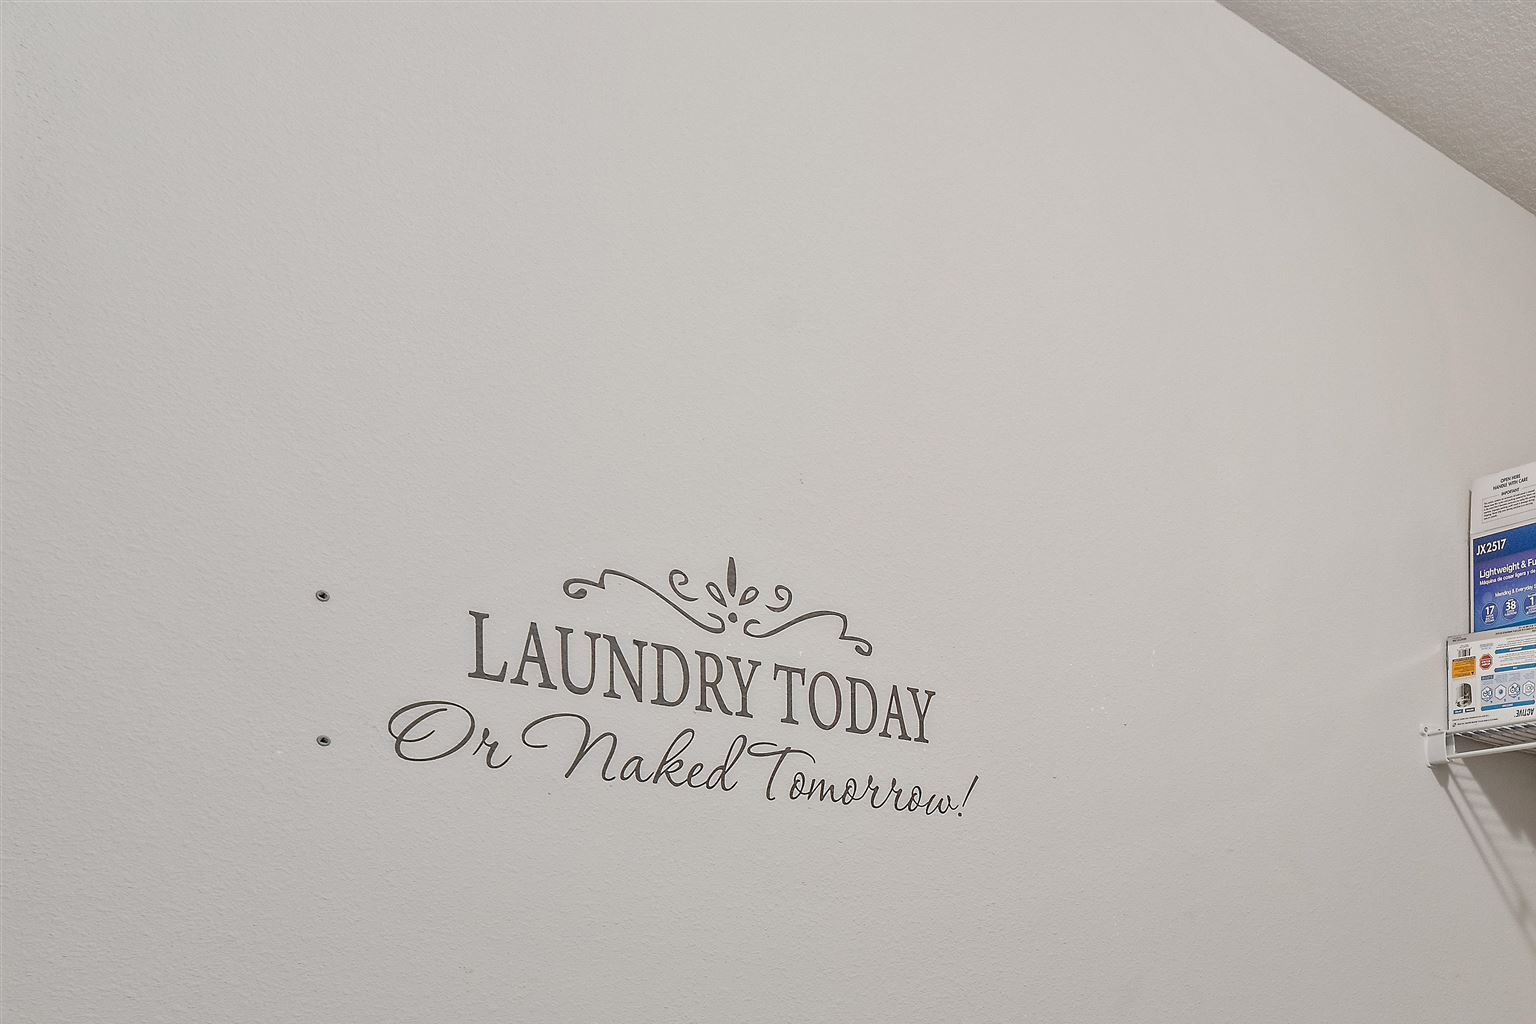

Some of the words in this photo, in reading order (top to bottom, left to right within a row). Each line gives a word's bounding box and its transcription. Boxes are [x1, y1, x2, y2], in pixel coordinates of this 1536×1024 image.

[1476, 539, 1507, 556] JX2517
[1480, 562, 1519, 578] Lightweight
[1521, 560, 1526, 568] &
[1485, 606, 1494, 615] 17
[1505, 601, 1516, 611] 38
[468, 610, 761, 719] LAUNDRY
[773, 664, 936, 744] TODAY
[388, 700, 513, 769] Or
[521, 712, 748, 793] Naked
[748, 741, 980, 818] Tomorrow!
